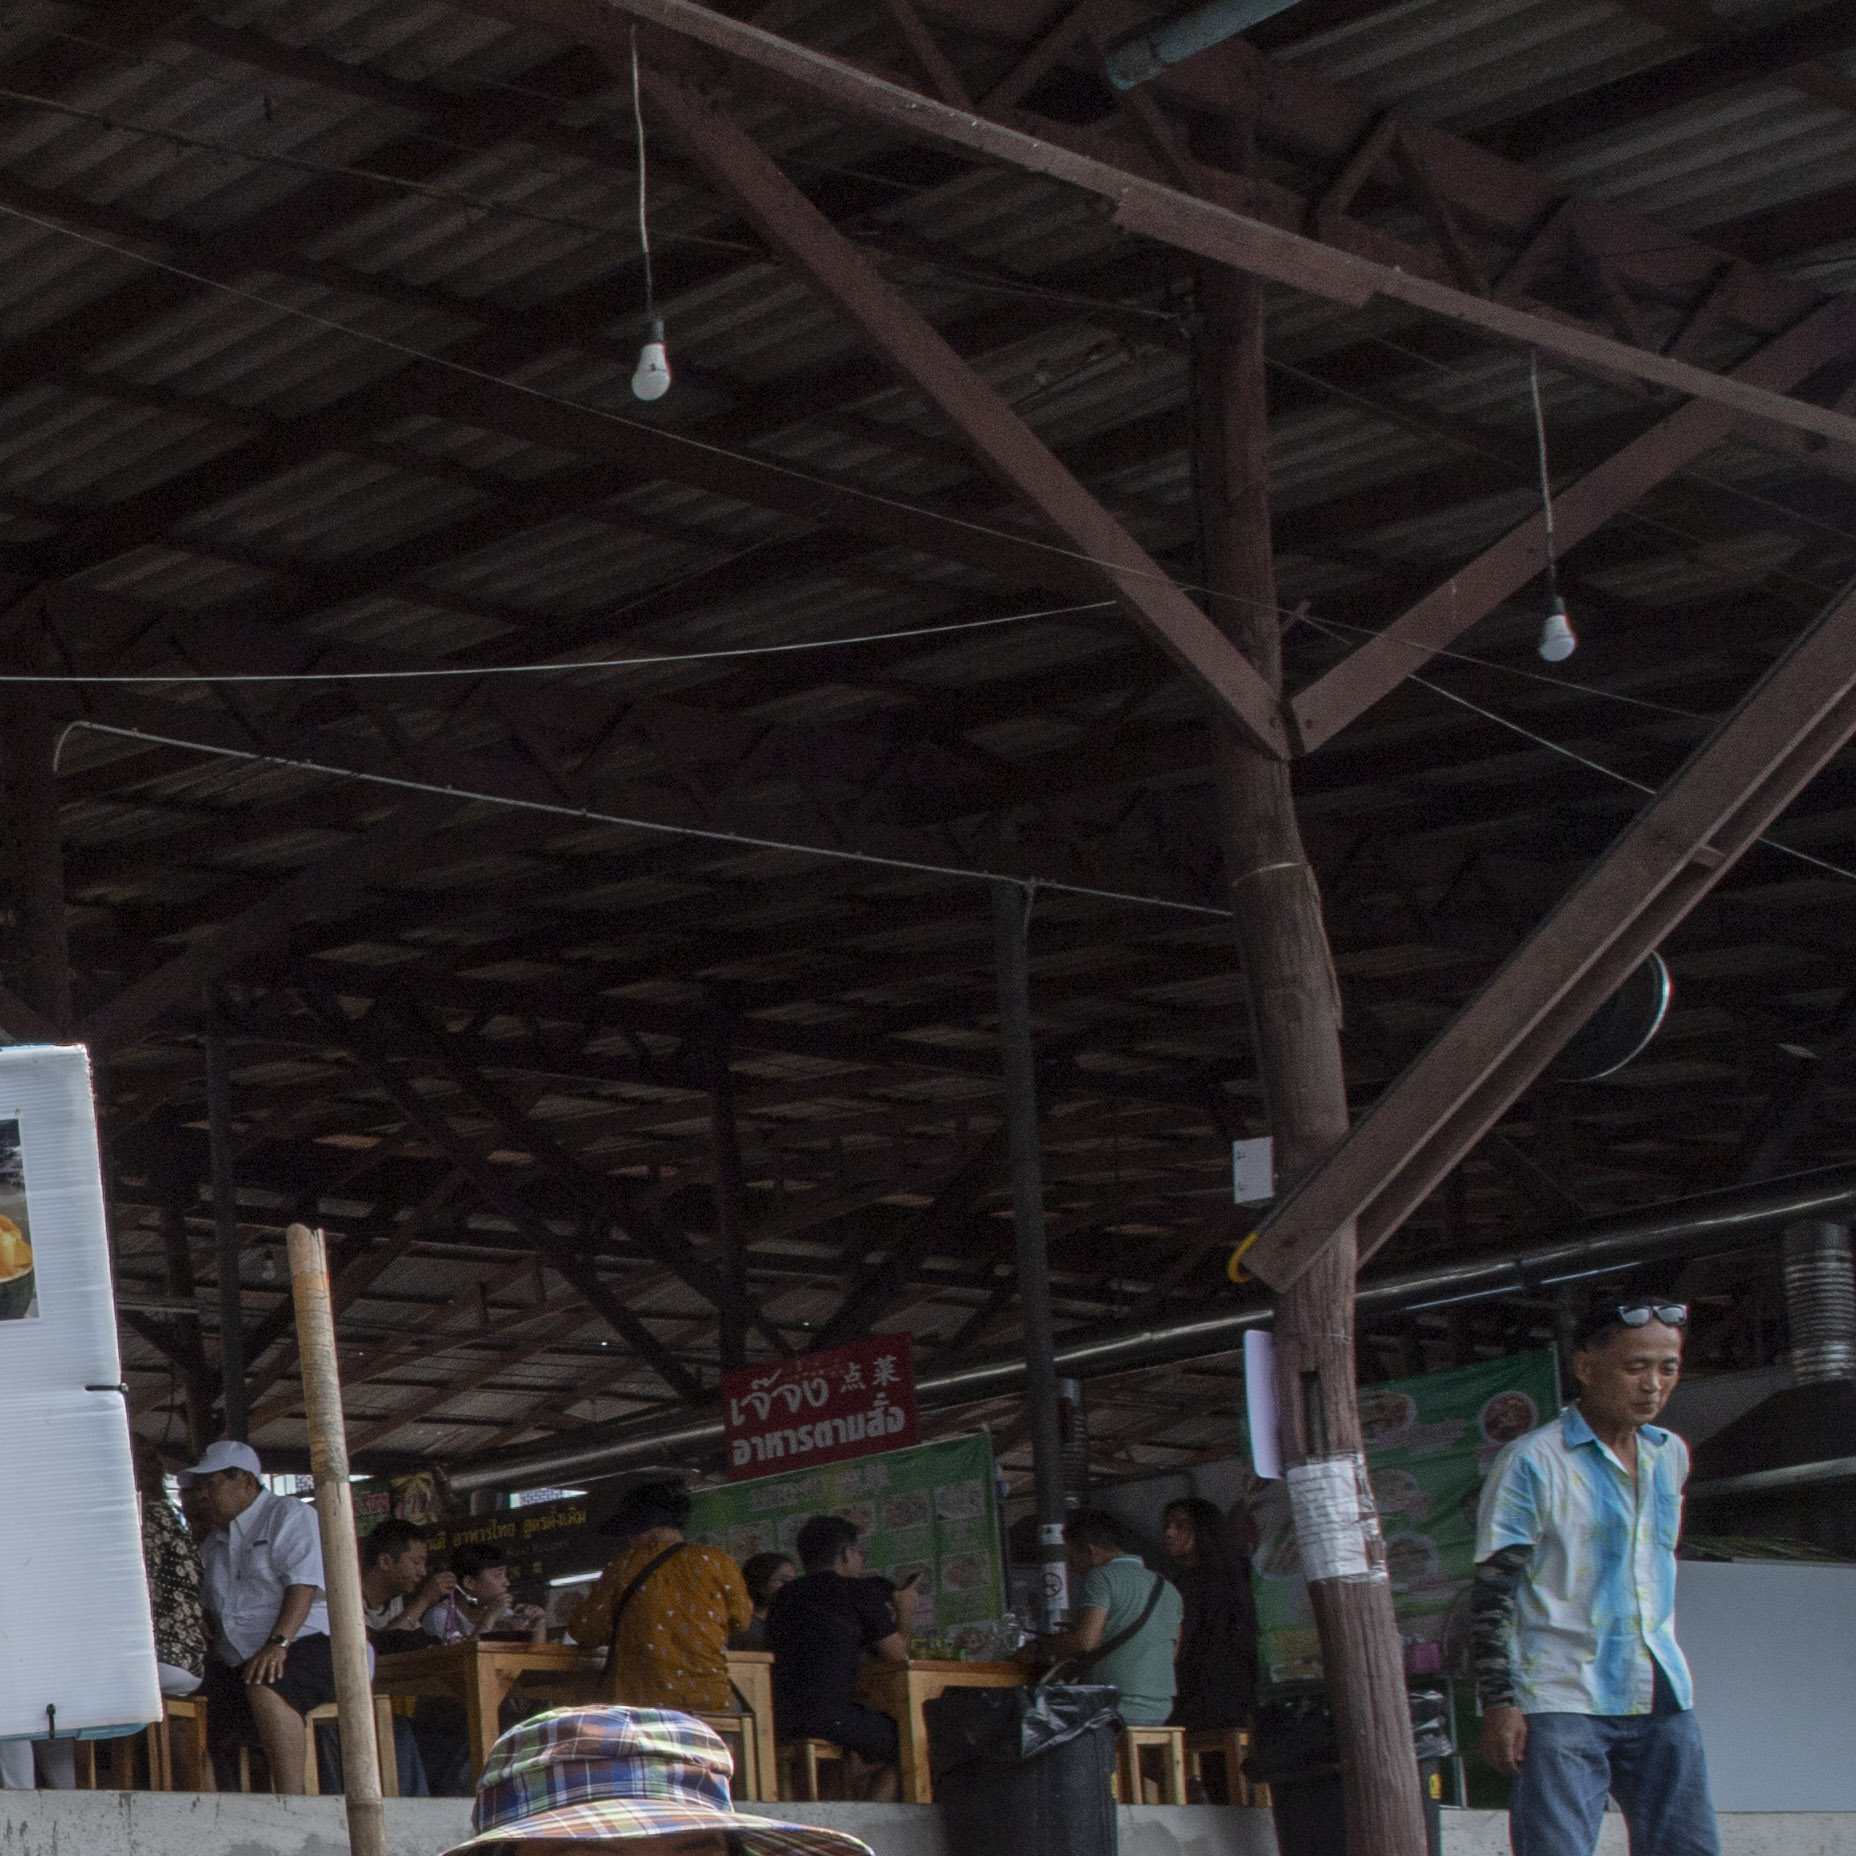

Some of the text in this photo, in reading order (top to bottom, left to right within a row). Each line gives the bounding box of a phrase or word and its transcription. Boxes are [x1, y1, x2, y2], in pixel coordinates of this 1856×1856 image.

[839, 1354, 901, 1393] 点菜
[732, 1391, 906, 1466] อาหารตามสั่ง
